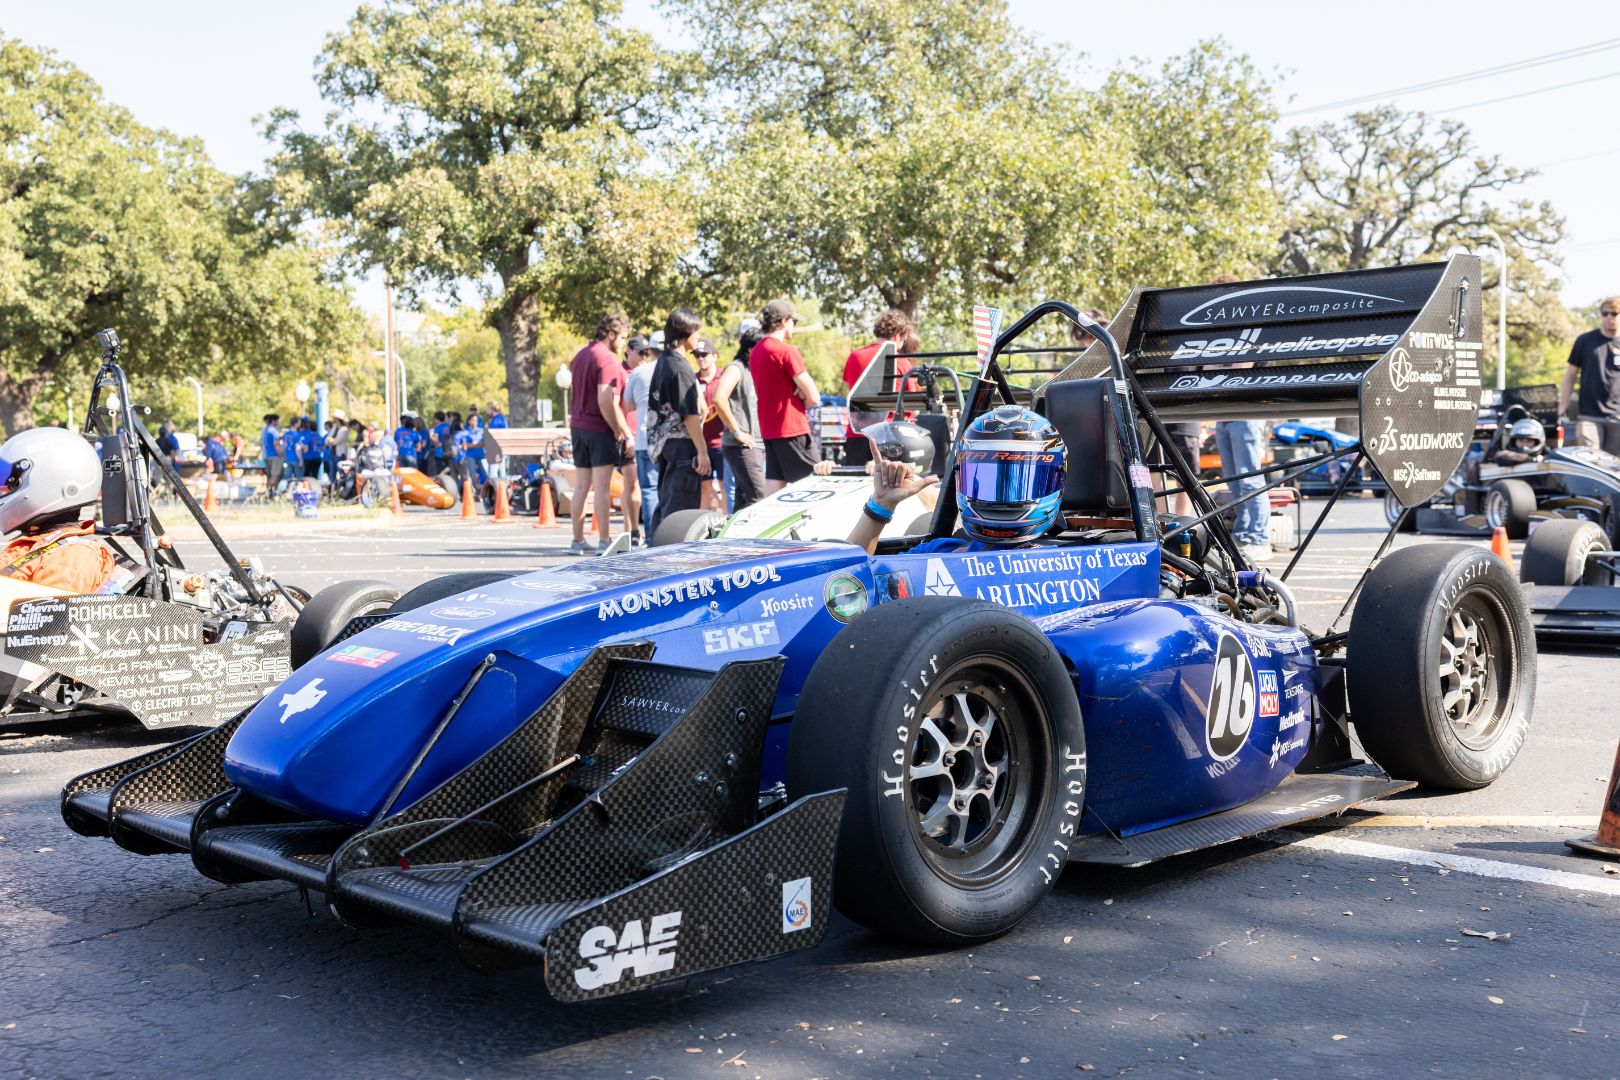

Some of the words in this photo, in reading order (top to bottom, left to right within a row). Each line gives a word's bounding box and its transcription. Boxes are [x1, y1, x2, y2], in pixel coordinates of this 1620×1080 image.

[1256, 334, 1399, 353] Helicopte
[1222, 372, 1362, 387] @UTARACIN
[1400, 433, 1464, 450] SOLIDWORKS
[991, 452, 1055, 463] Racing
[962, 555, 996, 577] The
[1000, 551, 1082, 576] University
[1085, 549, 1103, 568] of
[1103, 548, 1147, 567] Texas
[598, 577, 716, 622] MONSTER
[717, 563, 781, 592] TOOL
[976, 578, 1100, 608] ARLINGTON
[20, 603, 66, 614] Chevron
[760, 594, 814, 617] Hoosier
[9, 612, 54, 628] Phillips
[7, 634, 69, 648] NuEnergy
[106, 623, 198, 646] KANINI
[704, 621, 776, 654] SKF
[131, 658, 177, 672] FAMILY
[98, 676, 136, 688] KEVIN
[138, 673, 156, 684] YU
[182, 680, 226, 693] FAMILY
[1259, 673, 1277, 692] LIQUI
[1211, 653, 1254, 739] 16
[1260, 693, 1279, 713] MOLY
[1038, 744, 1087, 885] Hoosier
[574, 911, 682, 990] SAE
